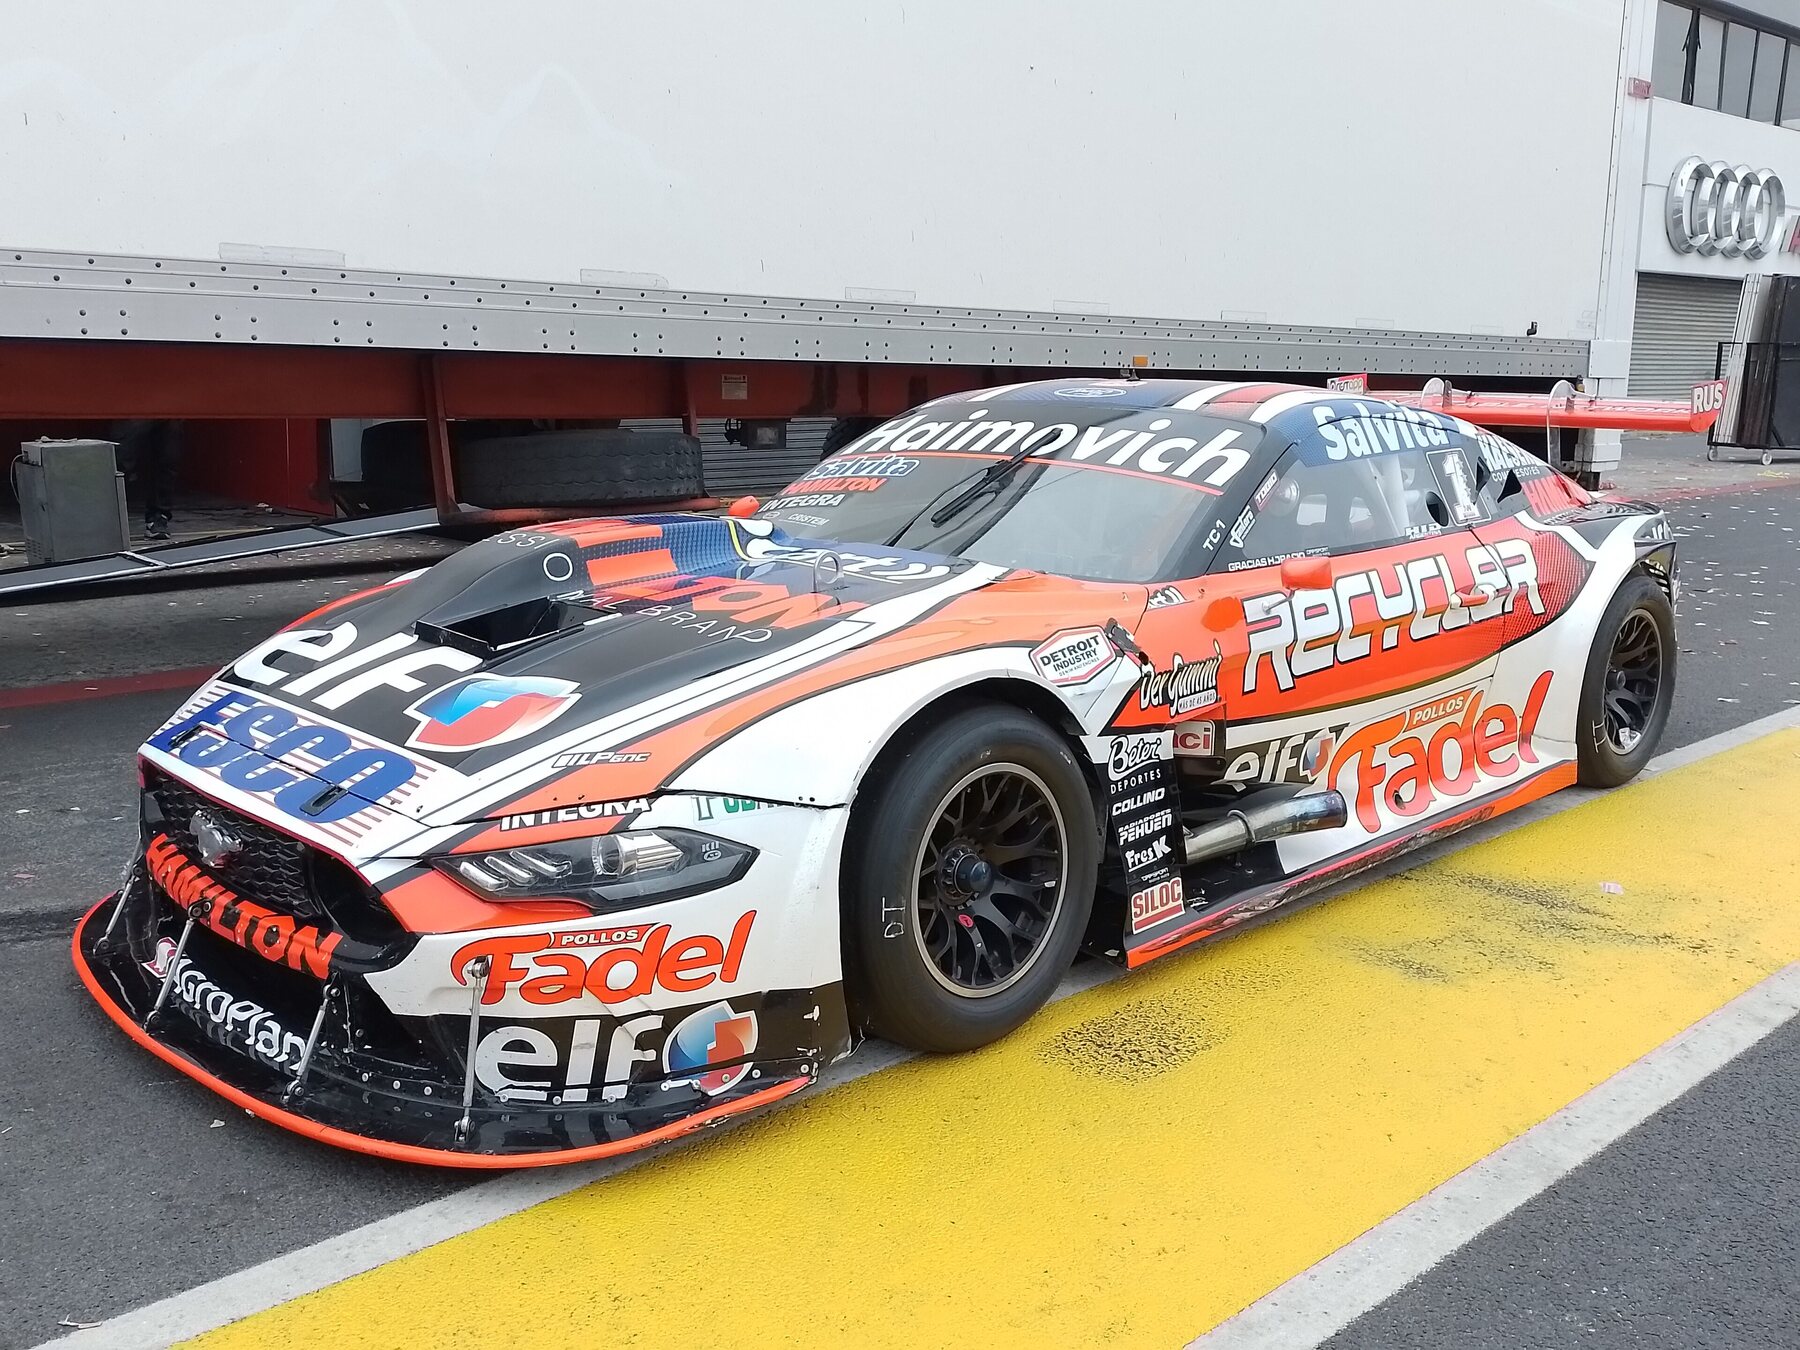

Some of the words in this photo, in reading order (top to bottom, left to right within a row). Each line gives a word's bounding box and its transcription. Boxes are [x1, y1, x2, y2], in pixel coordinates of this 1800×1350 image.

[1692, 383, 1723, 413] RUS
[1312, 402, 1450, 460] Salvita
[840, 409, 1252, 487] Haimovich
[810, 455, 915, 477] Salvita
[781, 477, 888, 496] HAMILTON
[757, 494, 846, 513] INTEGRA
[1228, 558, 1267, 571] GRACIAS
[641, 604, 774, 642] BRAND
[234, 621, 482, 711] elf
[1040, 634, 1100, 667] DETROIT
[1053, 648, 1098, 672] INDUSTRY
[1413, 695, 1464, 726] POLLOS
[1328, 670, 1554, 834] Fadel
[1110, 768, 1161, 795] DEPORTES
[501, 798, 651, 831] INTEGRA
[1112, 787, 1166, 816] COLLINO
[1118, 808, 1172, 833] RADIADORES
[1119, 813, 1173, 846] PEHUEN
[146, 833, 343, 979] HAMILTON
[1133, 879, 1181, 918] SILOC
[561, 929, 639, 945] POLLOS
[450, 909, 757, 1005] Fadel
[474, 1015, 664, 1102] elf
